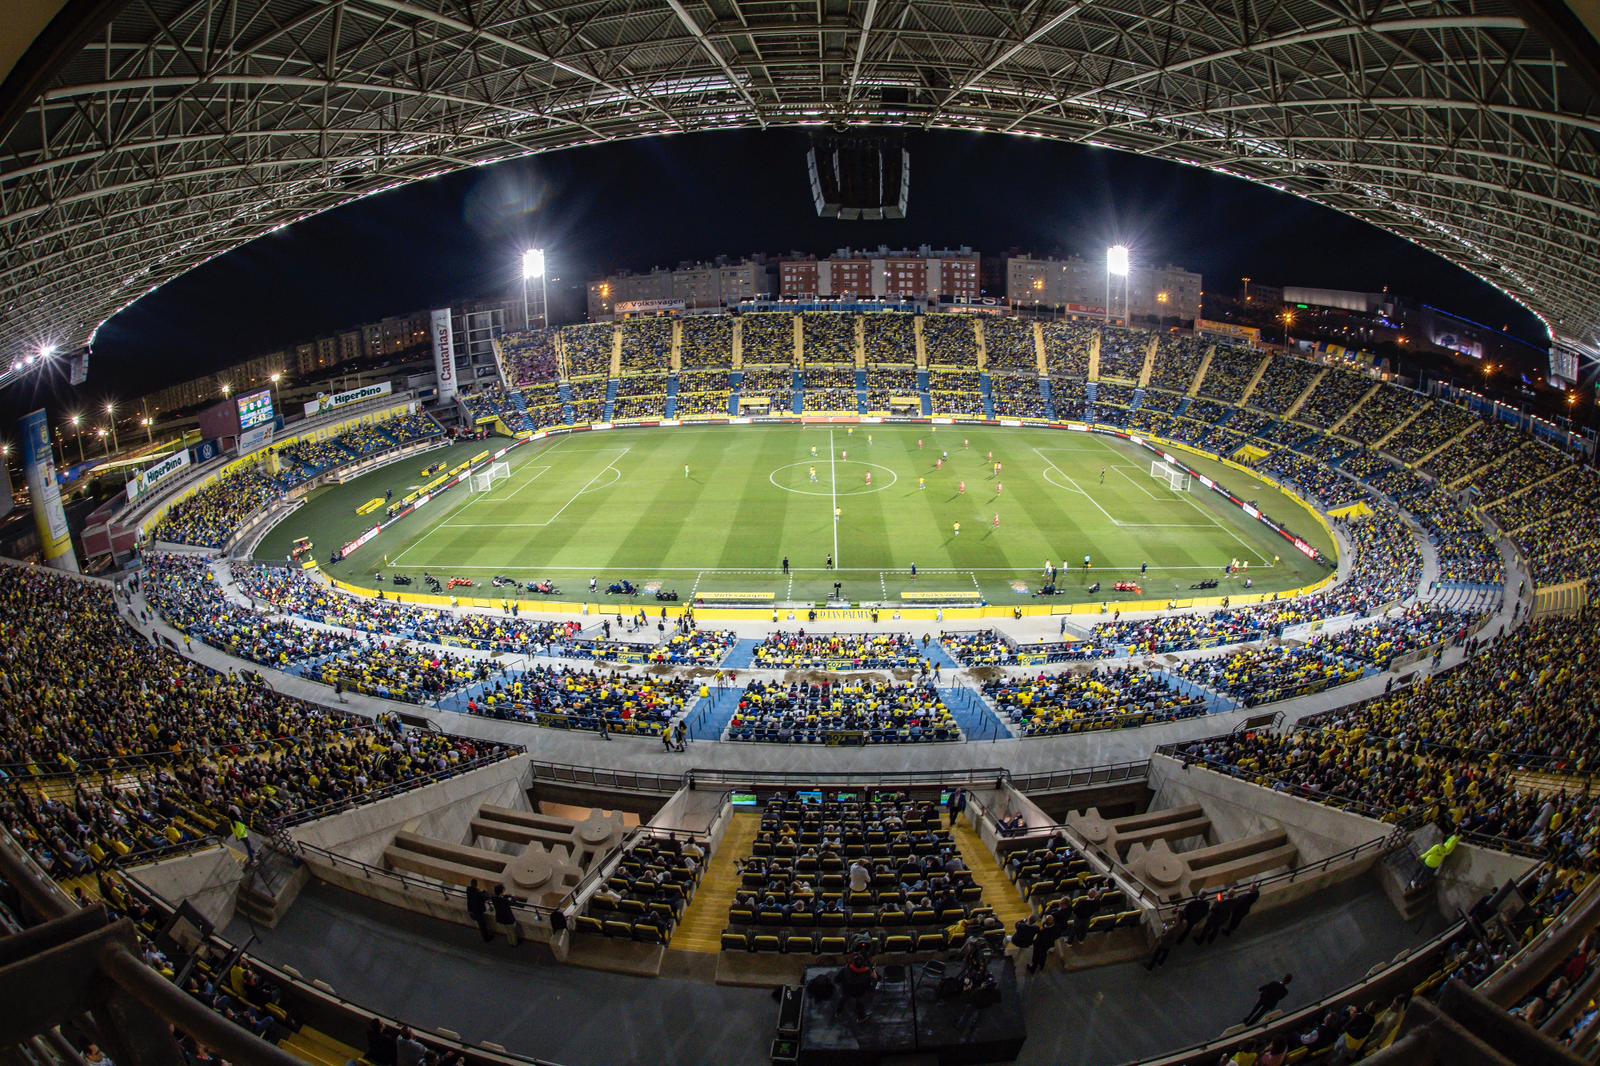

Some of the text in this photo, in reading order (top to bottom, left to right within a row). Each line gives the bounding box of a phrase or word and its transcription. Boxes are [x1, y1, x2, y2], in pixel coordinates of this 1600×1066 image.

[631, 299, 684, 307] Volkswagen
[334, 386, 382, 404] HiperDino
[147, 457, 182, 483] HiperDino
